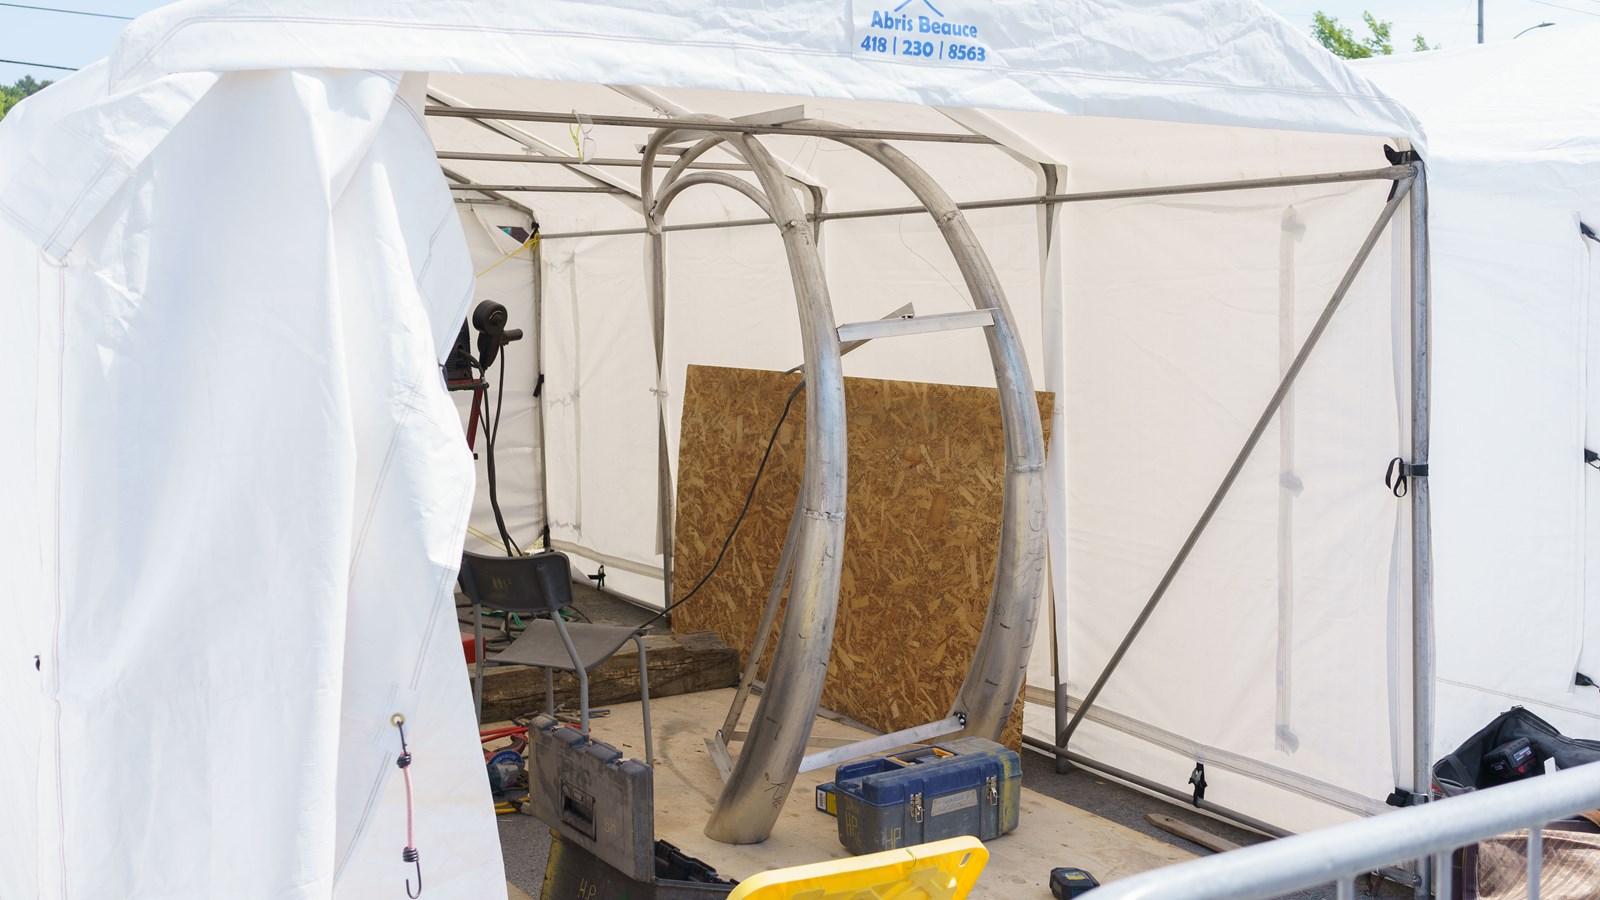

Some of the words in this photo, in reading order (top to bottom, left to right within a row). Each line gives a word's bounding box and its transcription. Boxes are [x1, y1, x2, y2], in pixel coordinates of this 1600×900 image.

[871, 10, 913, 32] Abris
[918, 15, 978, 38] Beauce
[860, 35, 887, 52] 418
[902, 40, 934, 57] 230
[948, 44, 985, 62] 8563
